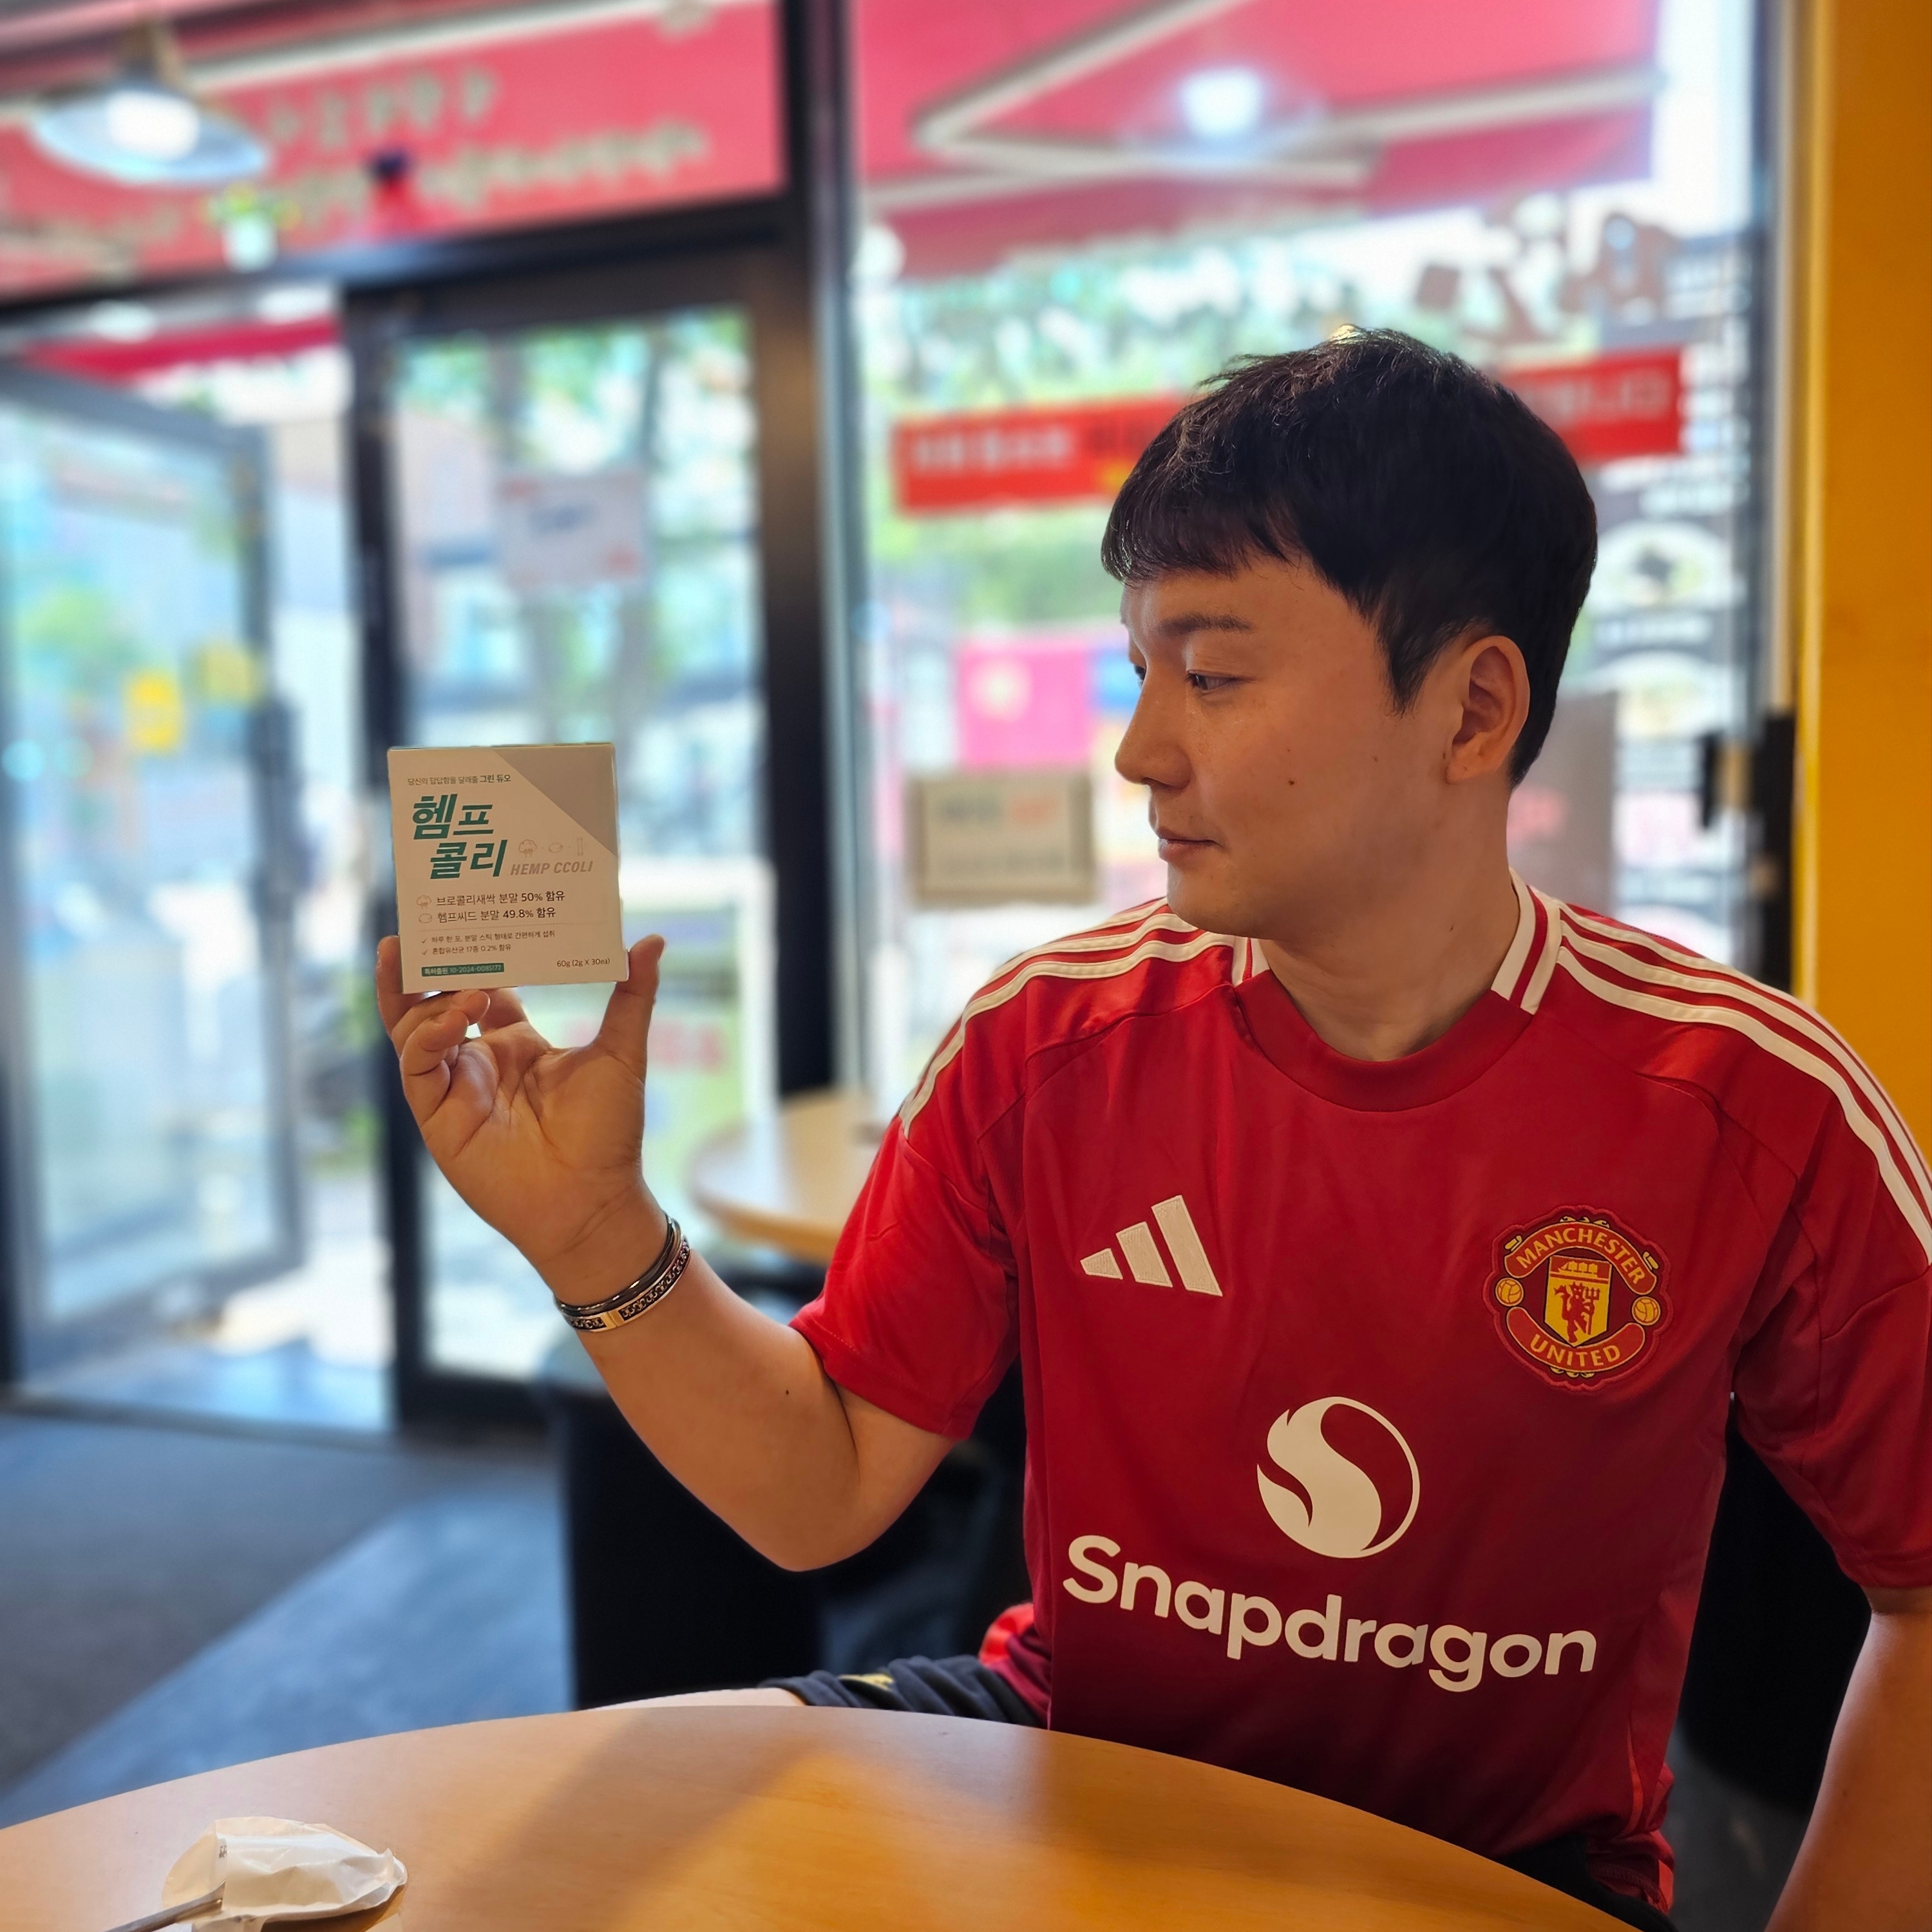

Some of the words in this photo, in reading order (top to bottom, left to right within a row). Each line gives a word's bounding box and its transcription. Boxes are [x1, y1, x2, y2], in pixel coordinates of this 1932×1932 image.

[408, 777, 428, 786] 당신의
[430, 776, 457, 785] 답답함을
[458, 775, 478, 784] 달래줄
[480, 774, 495, 783] 그린
[496, 774, 511, 783] 듀오
[412, 793, 494, 840] 헴프
[430, 839, 507, 879] 콜리
[510, 862, 550, 875] HEMP
[553, 860, 593, 874] CCOLI
[437, 894, 495, 905] 브로콜리새싹
[499, 893, 518, 904] 분말
[521, 893, 543, 902] 50%
[545, 891, 565, 902] 함유
[438, 911, 477, 923] 헴프씨드
[480, 910, 500, 920] 분말
[503, 909, 534, 918] 49.8%
[536, 907, 556, 918] 함유
[432, 946, 464, 954] 혼합유산균
[572, 959, 583, 967] (2g
[1517, 1227, 1645, 1284] MANCHESTER
[1530, 1333, 1621, 1367] UNITED
[1063, 1535, 1597, 1692] Snapdragon
